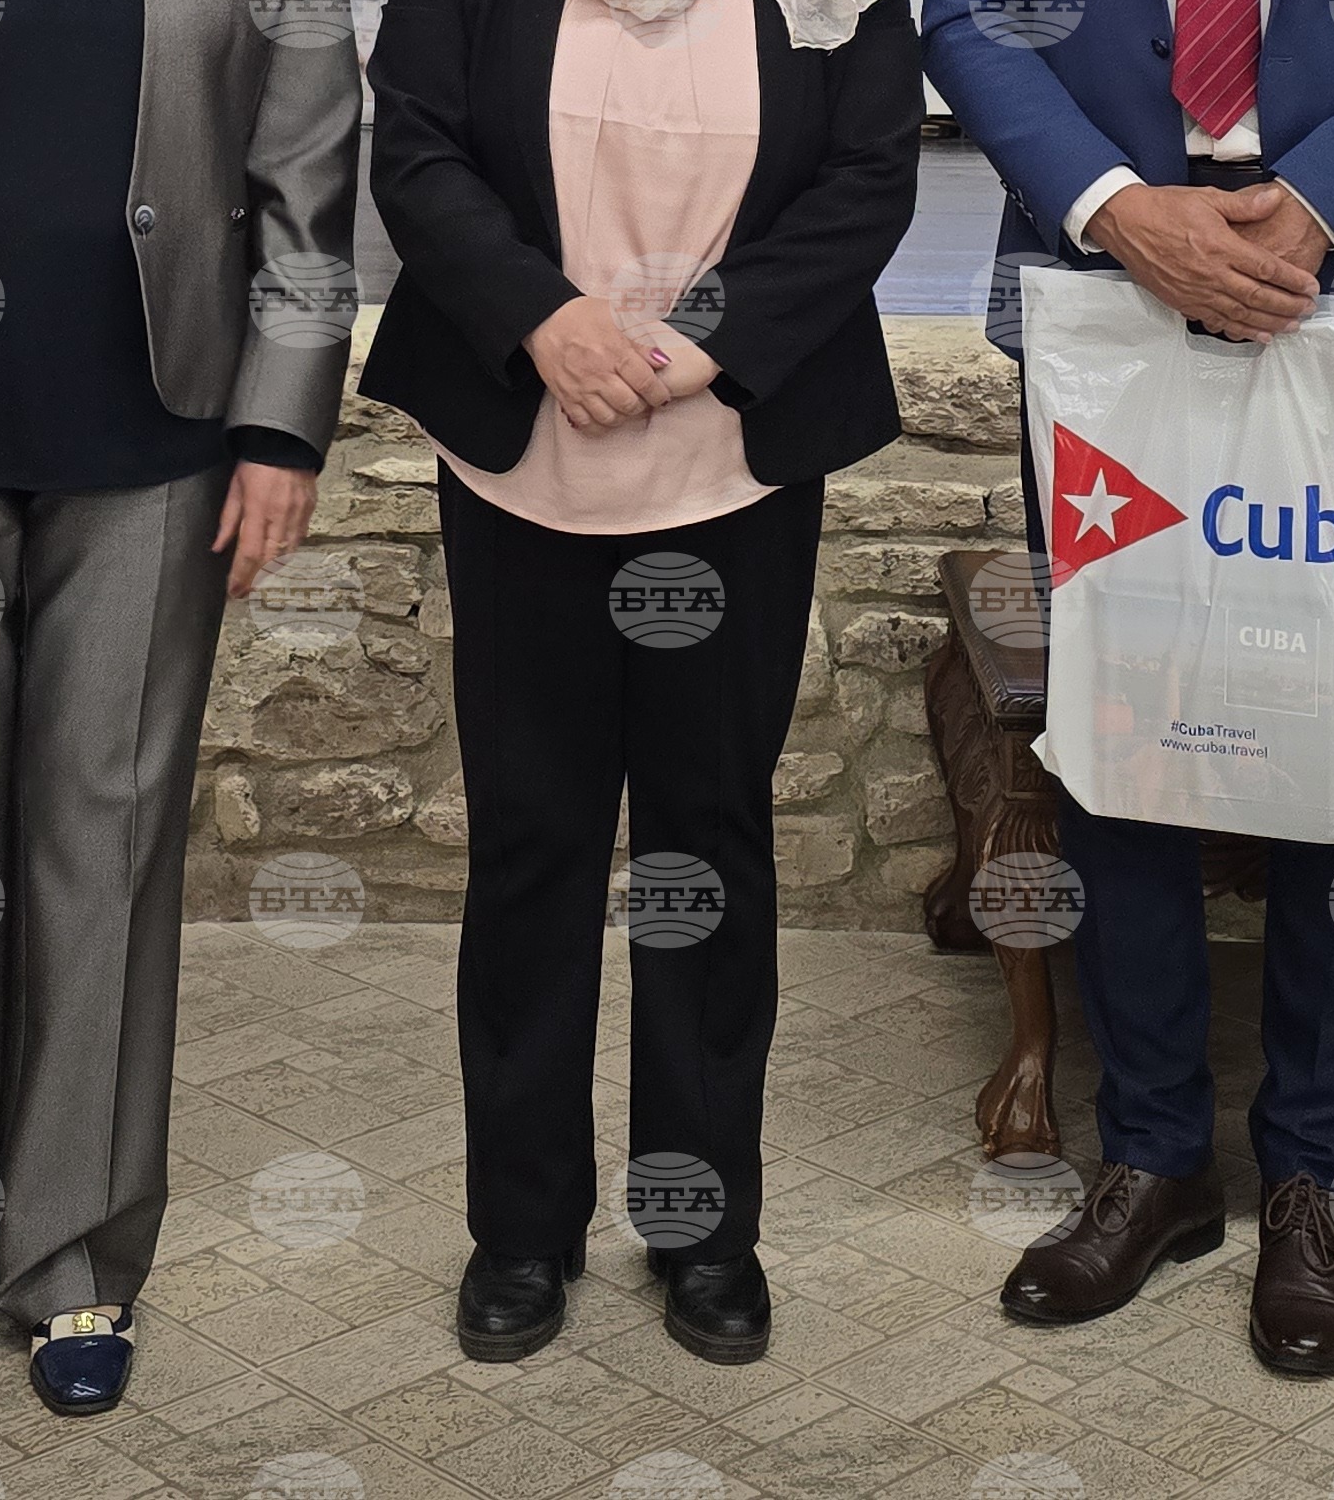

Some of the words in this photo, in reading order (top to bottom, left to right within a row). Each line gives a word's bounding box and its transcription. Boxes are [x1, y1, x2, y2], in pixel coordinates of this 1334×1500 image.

[1238, 626, 1307, 653] CUBA
[1170, 720, 1256, 740] #CubaTravel
[1160, 738, 1268, 759] www.cuba.travel
